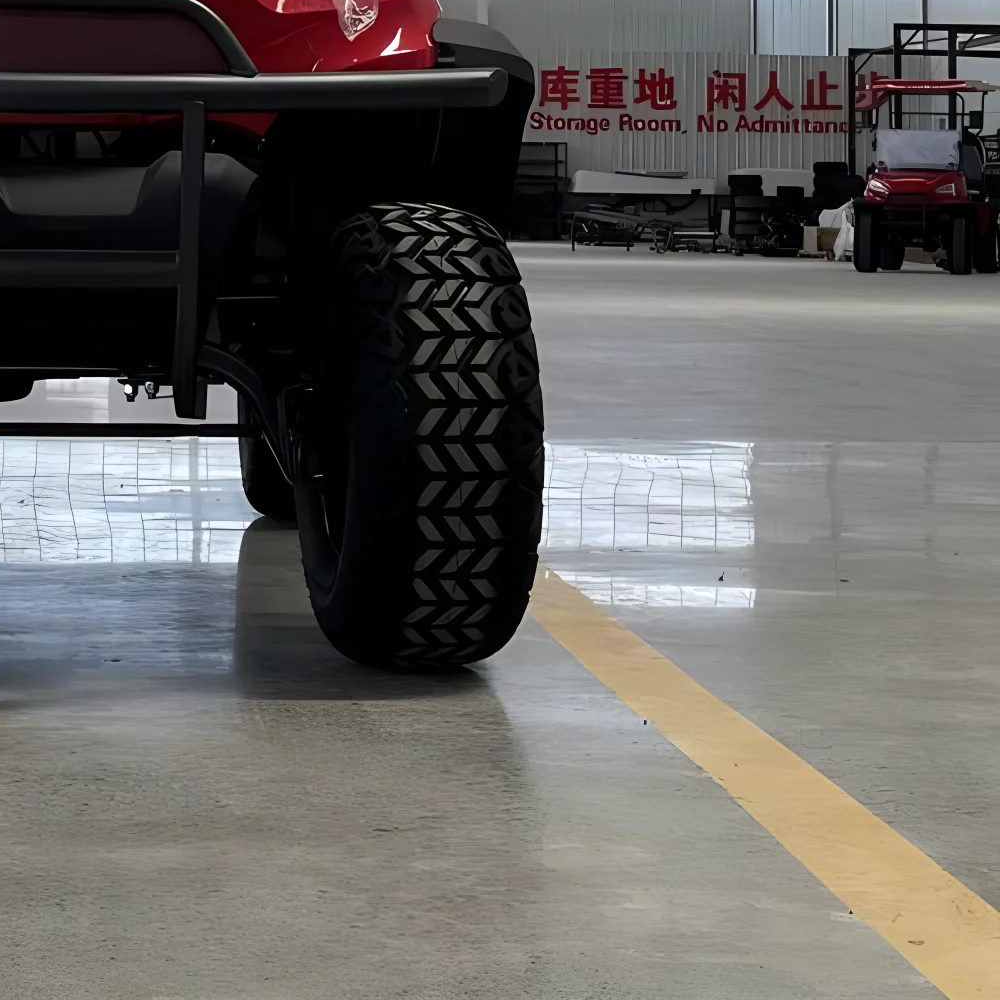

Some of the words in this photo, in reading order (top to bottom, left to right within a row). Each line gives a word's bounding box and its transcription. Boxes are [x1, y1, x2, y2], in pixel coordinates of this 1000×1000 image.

[539, 65, 678, 111] 库重地
[697, 114, 729, 133] No
